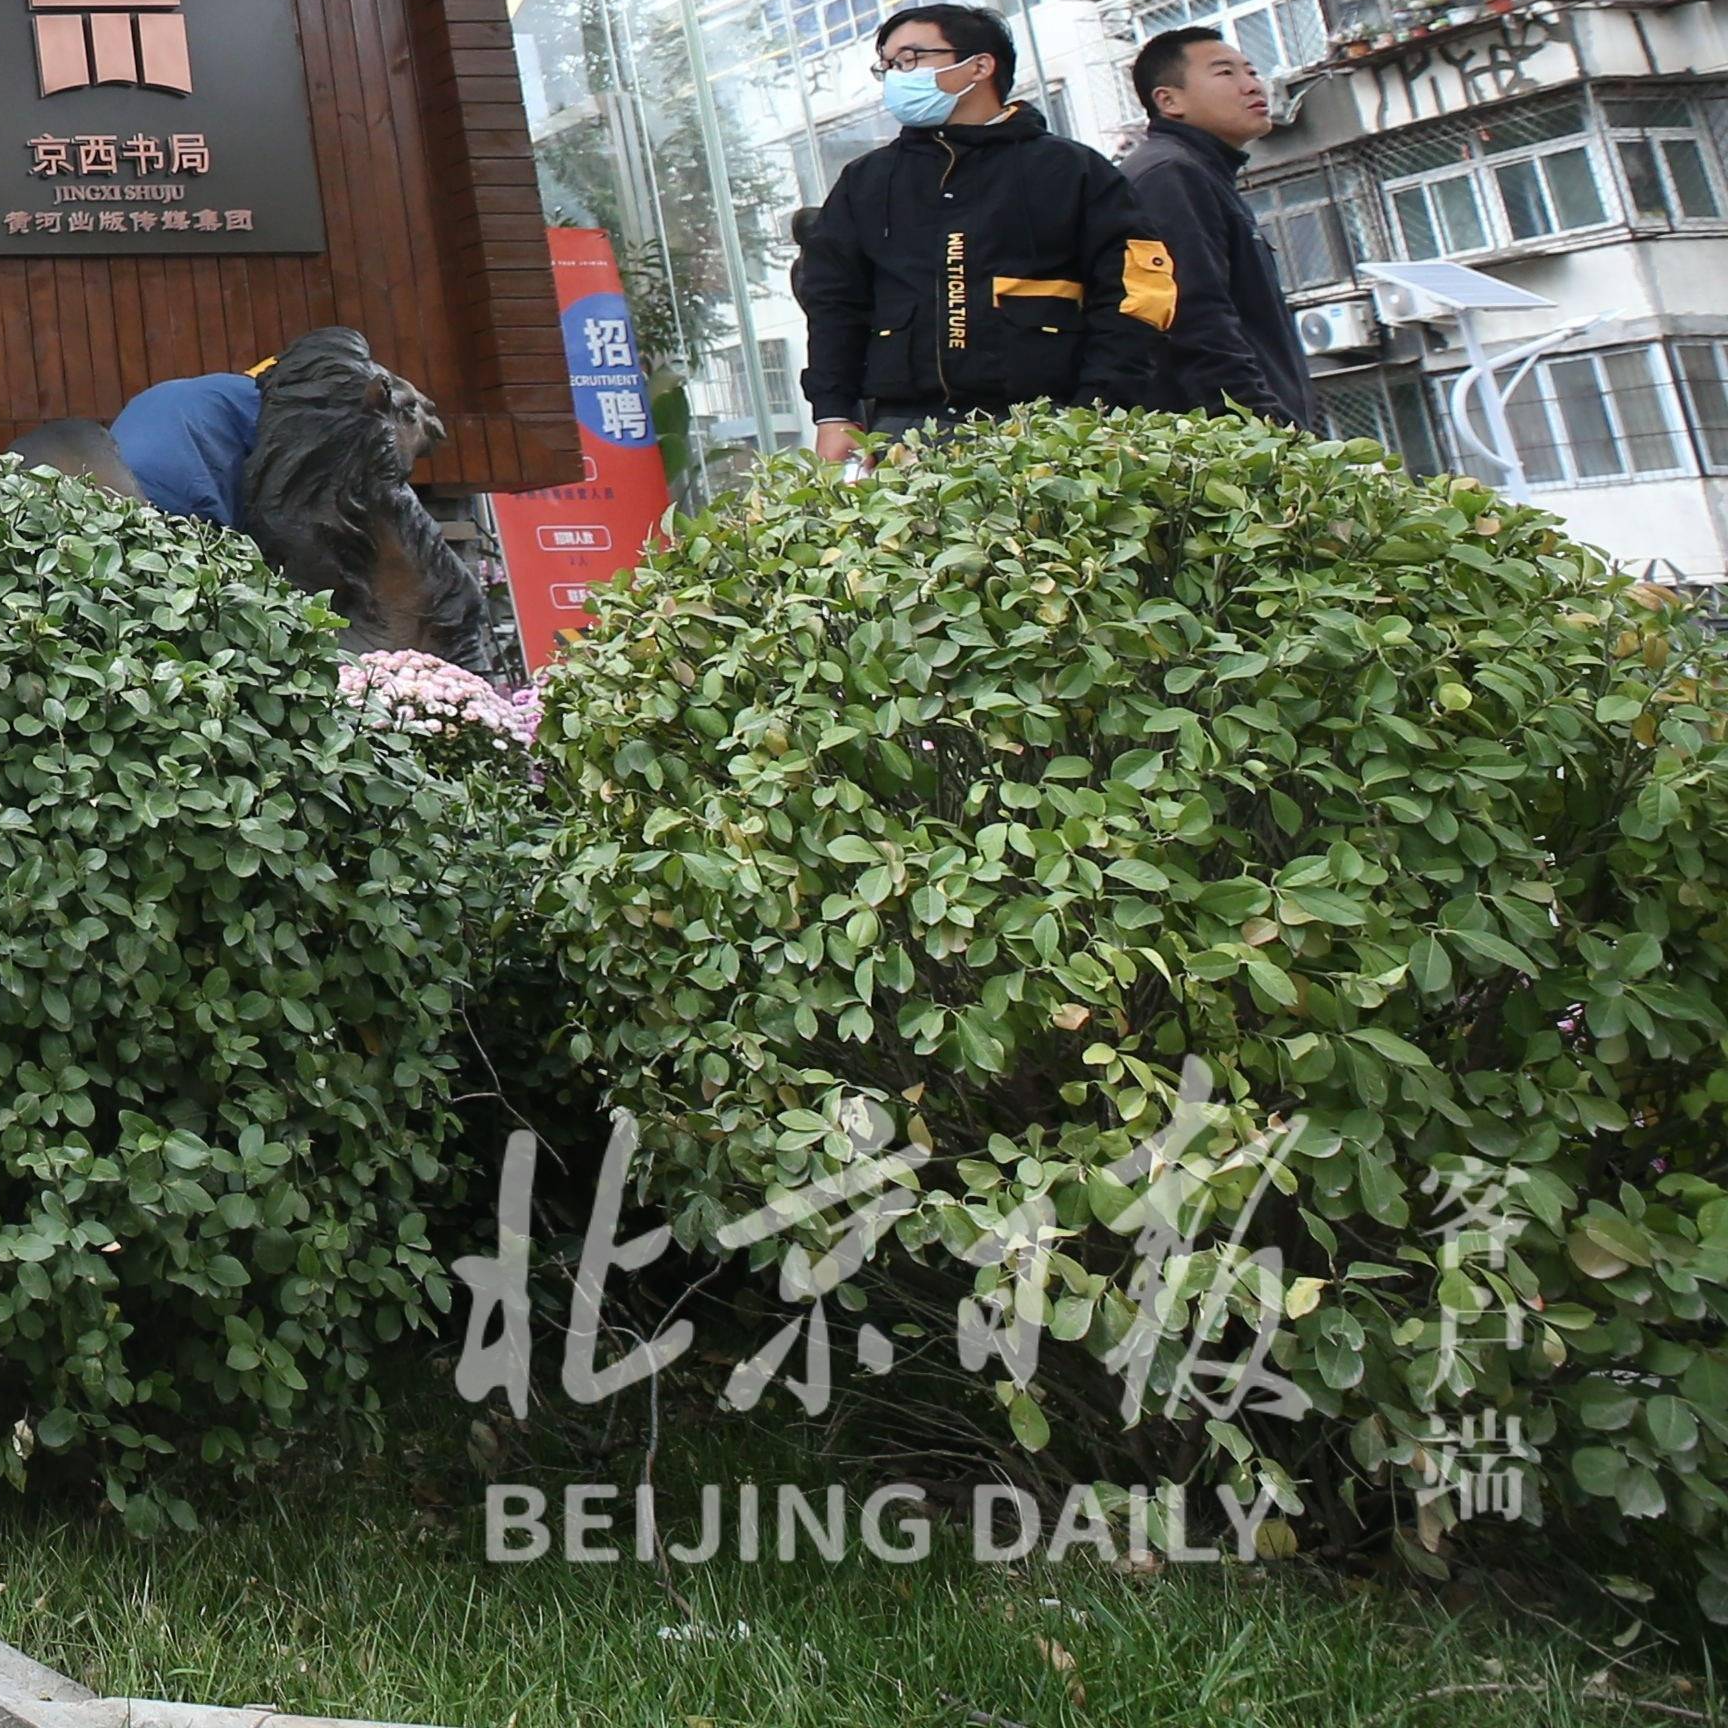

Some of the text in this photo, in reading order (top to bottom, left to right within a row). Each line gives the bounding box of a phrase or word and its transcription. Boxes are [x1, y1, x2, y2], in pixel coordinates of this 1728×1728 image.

[28, 132, 209, 176] 京西书局
[54, 183, 185, 204] JINGXI SHUJU
[3, 208, 254, 235] 黄河出版传媒集团
[947, 232, 966, 349] MULTICULTURE
[583, 318, 633, 367] 招
[569, 374, 640, 387] ECRUITMENT
[596, 389, 647, 440] 聘
